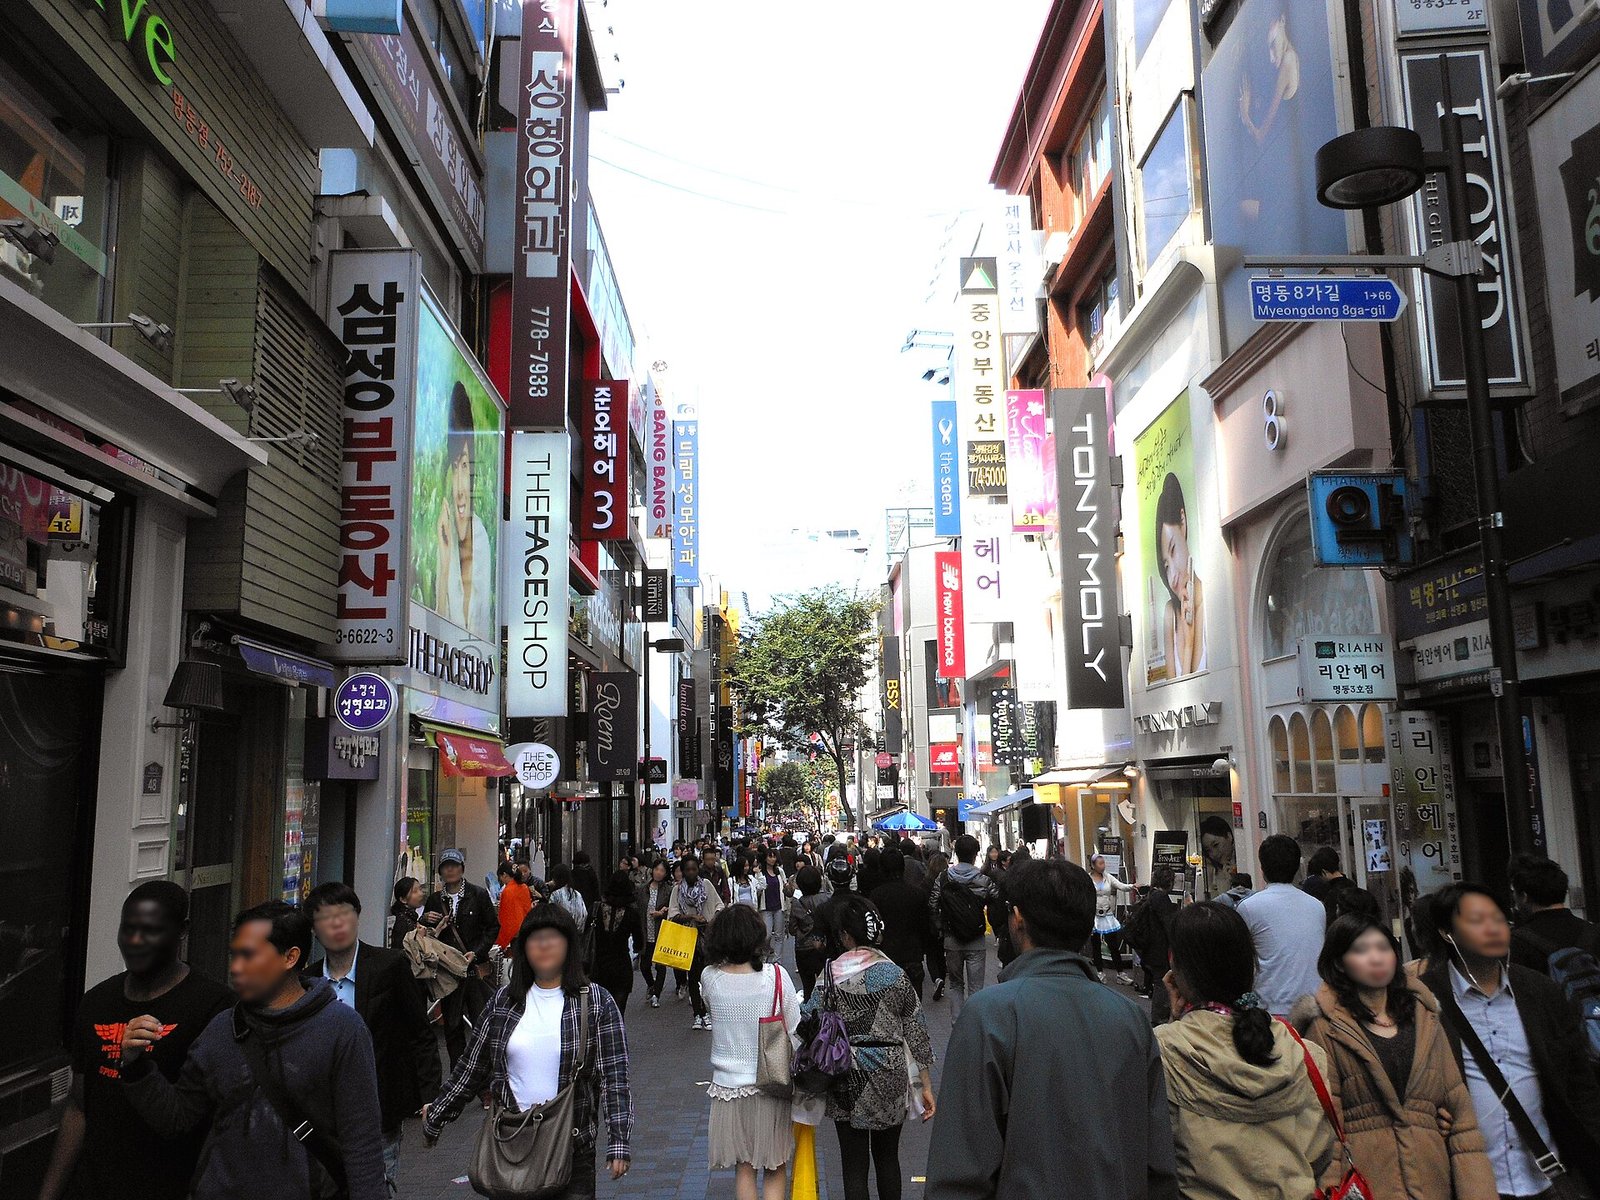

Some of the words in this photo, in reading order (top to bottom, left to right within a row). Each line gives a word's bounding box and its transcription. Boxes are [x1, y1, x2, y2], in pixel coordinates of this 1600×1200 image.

[1467, 9, 1483, 21] 2F
[213, 139, 263, 210] 752-2187
[522, 69, 567, 256] 성형외과
[1424, 172, 1440, 207] HE
[1428, 211, 1444, 248] GIF
[1256, 283, 1340, 303] 명동8가길
[1257, 304, 1339, 318] Myeongdong
[1342, 304, 1386, 318] 8ga-gil
[529, 305, 551, 398] 778-7933
[970, 302, 996, 433] 중앙부동산
[336, 281, 405, 620] 삼정부동산
[593, 387, 617, 484] 준오헤어
[653, 409, 666, 462] BANG
[939, 451, 954, 474] the
[967, 466, 1008, 488] 774-5000
[653, 465, 666, 519] BANG
[677, 440, 696, 568] 드림성모안과
[940, 476, 952, 517] saem
[1022, 513, 1039, 525] 3F
[1071, 413, 1107, 682] TONYMOLY
[972, 536, 1000, 599] 헤어
[942, 591, 952, 615] new
[942, 617, 955, 667] balance
[1338, 641, 1384, 653] RIAHN
[1472, 634, 1492, 653] RIA
[1318, 664, 1386, 680] 리안헤어
[351, 683, 377, 697] 노정식
[679, 683, 693, 718] banila
[886, 679, 899, 710] BSX
[1332, 684, 1375, 695] 명동3호점
[340, 698, 388, 717] 성형외과
[593, 681, 621, 766] Roem
[522, 762, 553, 772] FACE
[523, 752, 546, 762] THE
[147, 777, 157, 791] 48
[522, 771, 553, 782] SHOP
[1411, 729, 1445, 868] 리안헤어
[659, 945, 683, 958] FOREVER
[683, 951, 690, 959] 21
